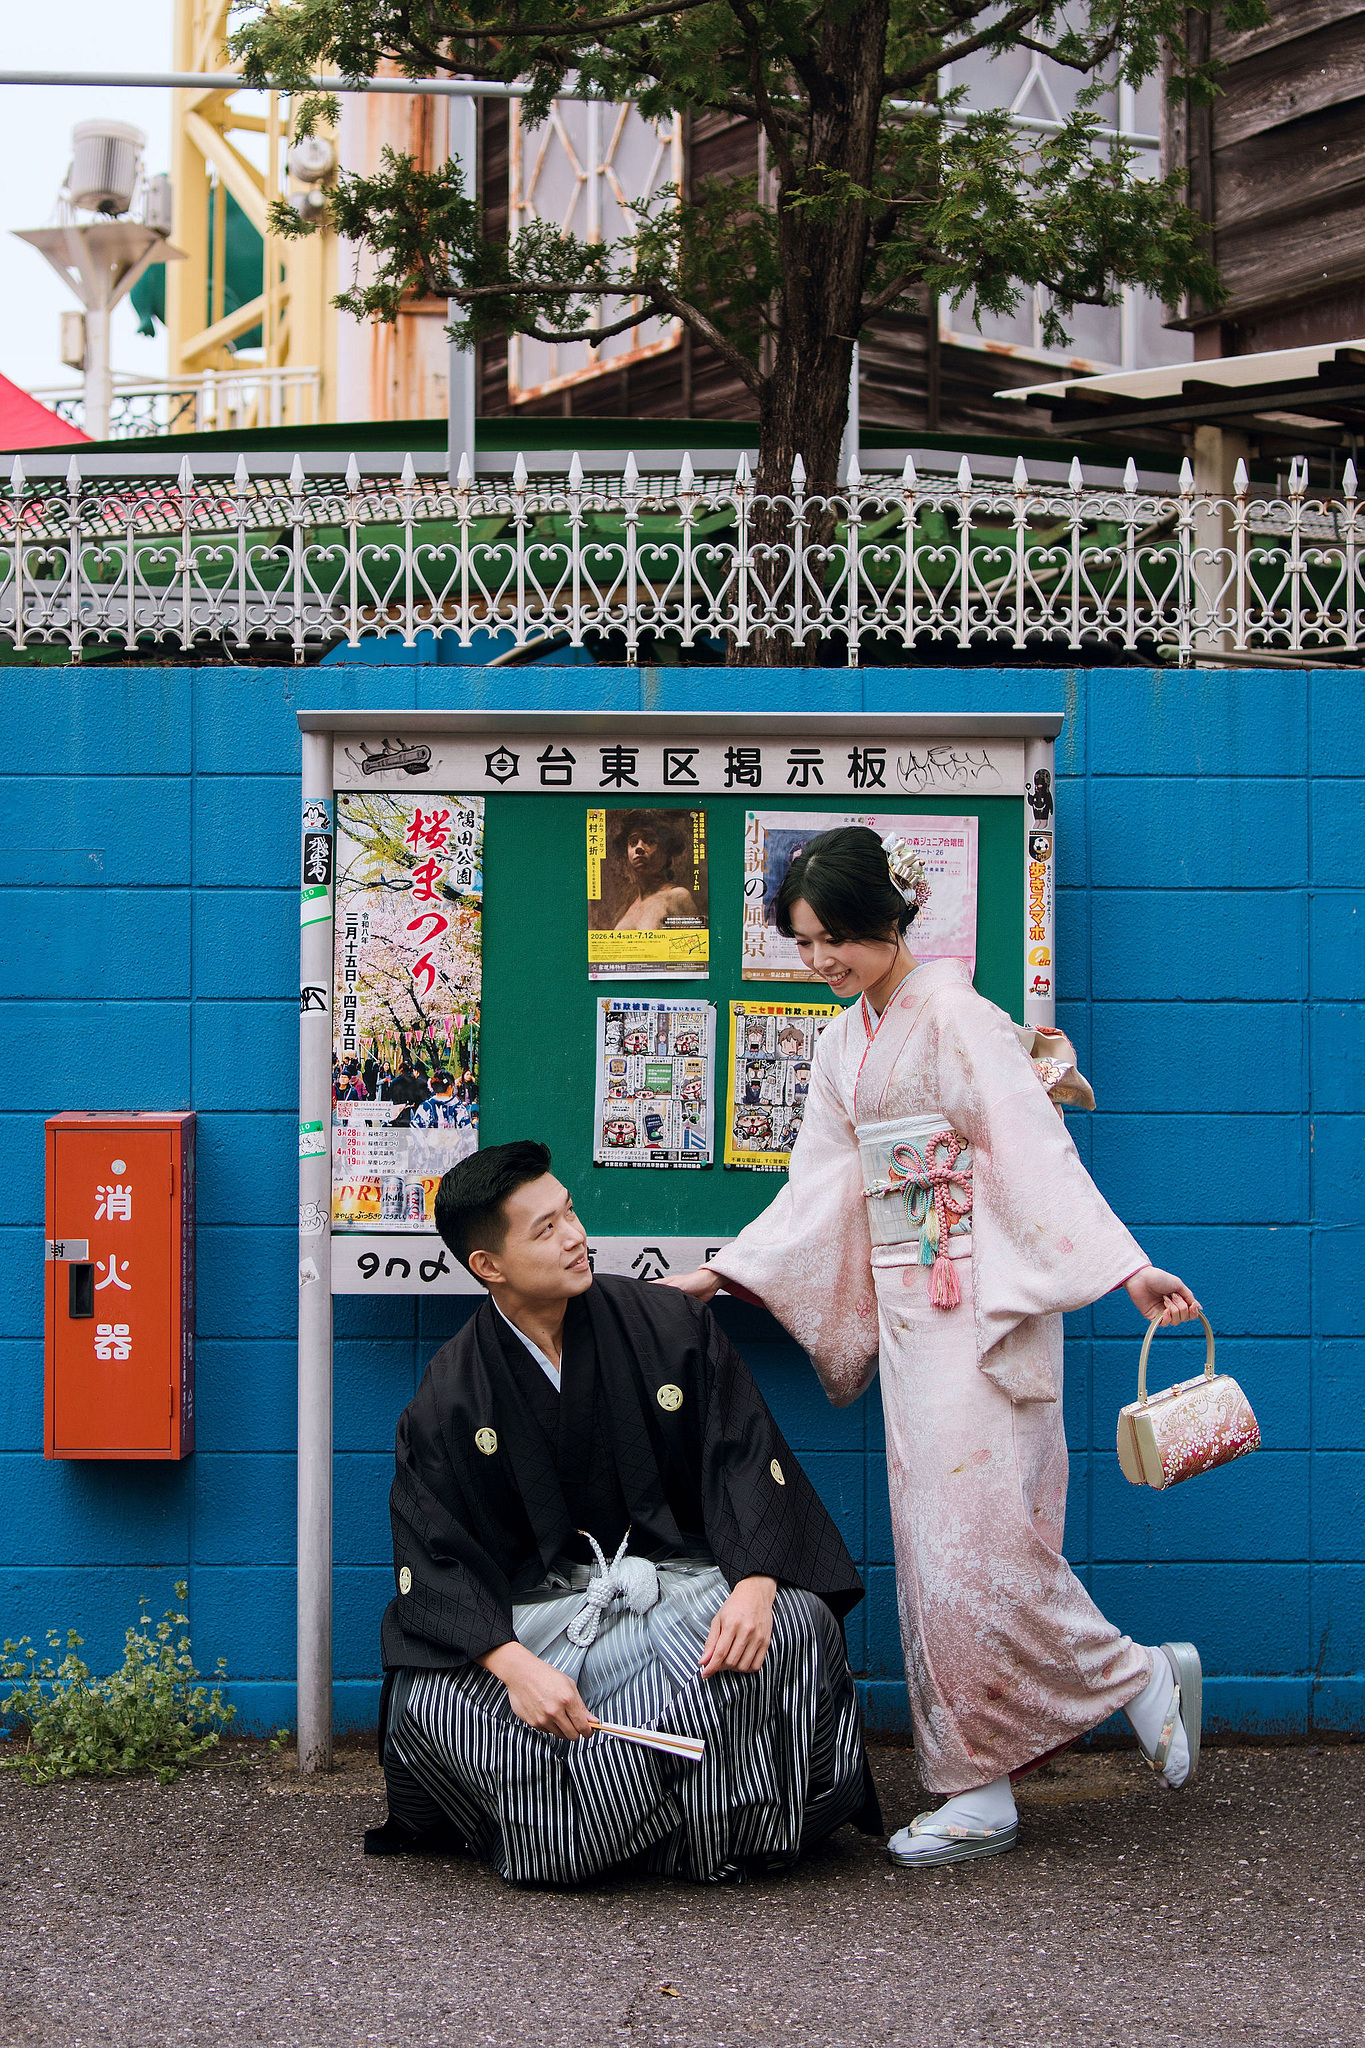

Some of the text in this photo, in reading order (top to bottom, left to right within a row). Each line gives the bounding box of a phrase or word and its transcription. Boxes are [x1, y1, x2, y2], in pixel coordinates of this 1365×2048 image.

[536, 745, 887, 788] 台東区掲示板
[456, 810, 475, 886] 隅田公園
[589, 813, 598, 855] 中村不折
[405, 808, 452, 998] 桜まつり
[744, 818, 770, 958] 小説の風景
[1029, 862, 1046, 941] 歩きスマホ
[361, 912, 370, 944] 令和八年
[51, 1242, 66, 1258] 封
[94, 1184, 132, 1361] 消火器
